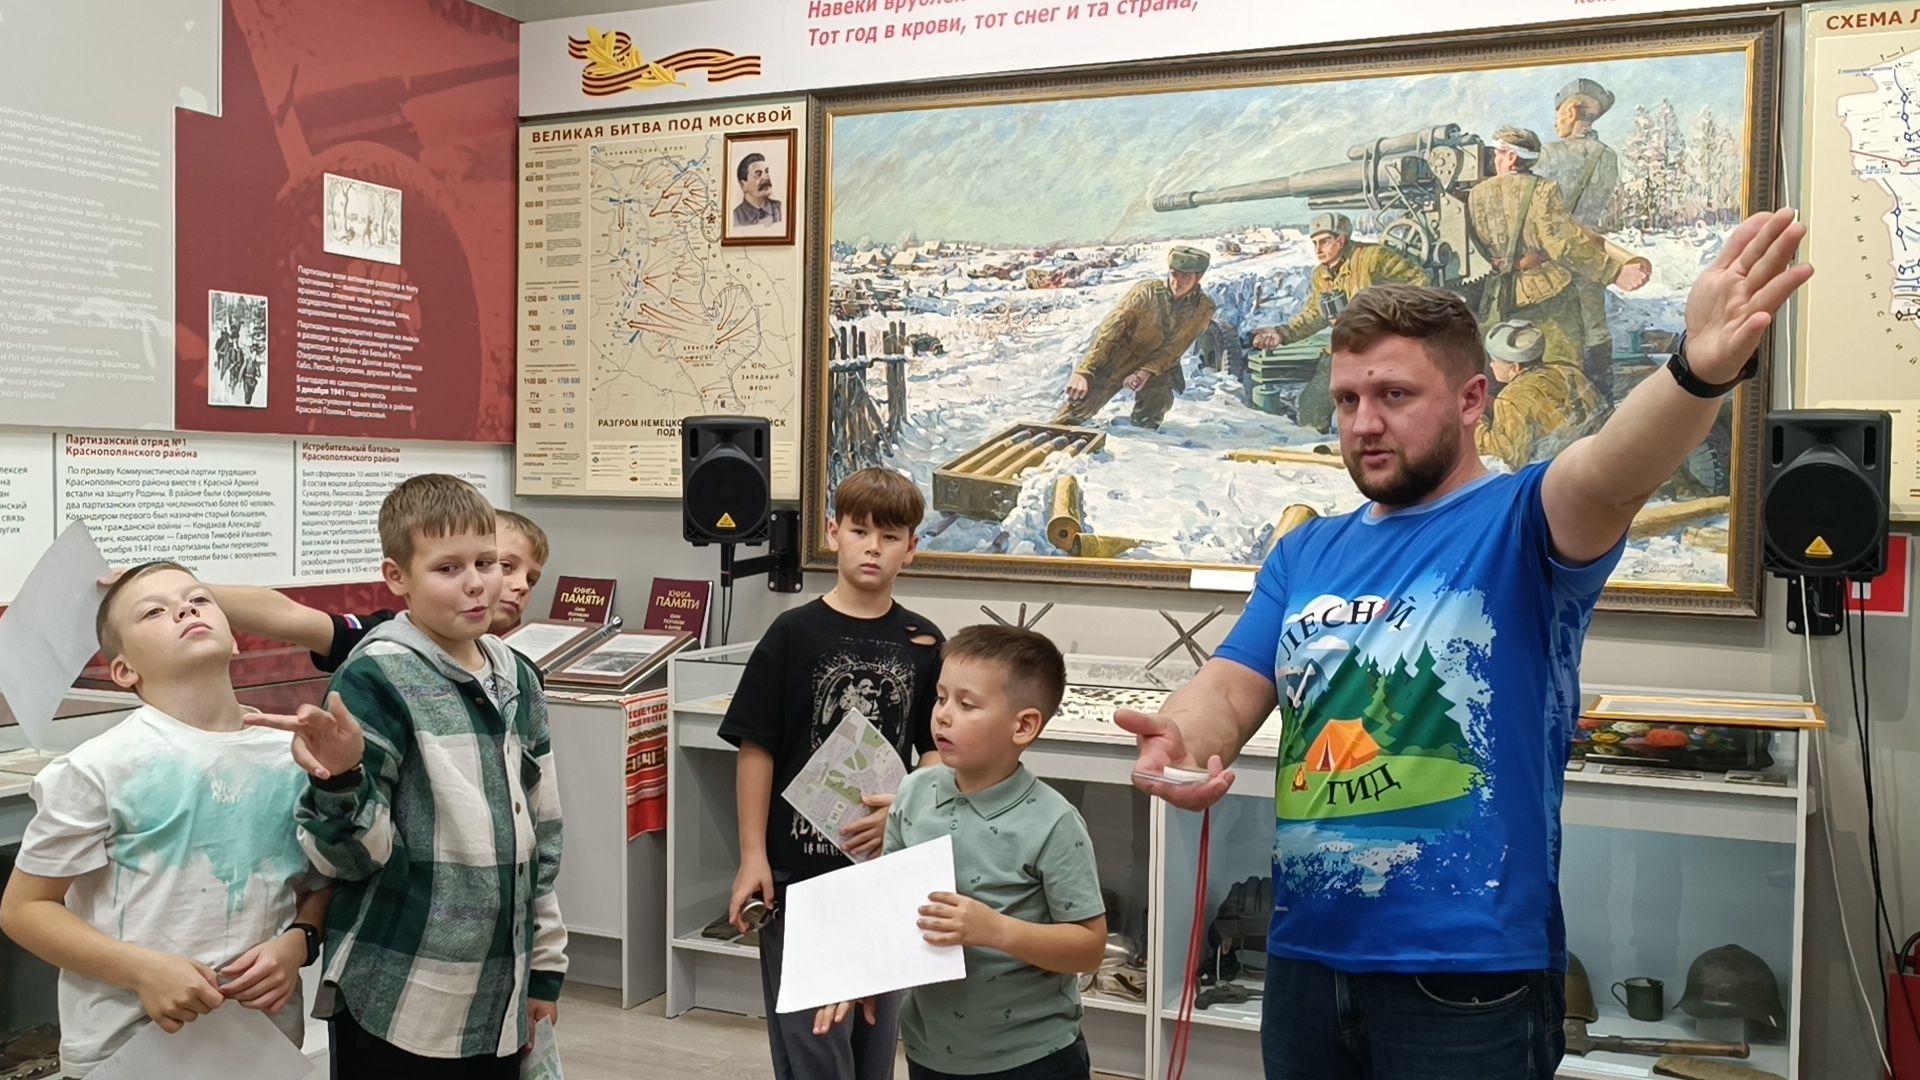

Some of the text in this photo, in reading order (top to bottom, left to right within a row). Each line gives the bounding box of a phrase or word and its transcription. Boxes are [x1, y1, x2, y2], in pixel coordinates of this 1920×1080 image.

[808, 0, 877, 18] Навеки
[808, 0, 1199, 46] Тот год в крови, тот снег и та страна,
[1826, 10, 1903, 30] СХЕМА
[532, 106, 792, 143] ВЕЛИКАЯ БИТВА ПОД МОСКВОЙ
[330, 387, 344, 395] 1941
[598, 419, 639, 428] РАЗГРОМ
[657, 428, 676, 438] ПОД
[65, 434, 138, 446] Партизанский
[140, 438, 169, 447] отряд
[65, 446, 197, 459] Краснополянского района
[302, 442, 400, 453] Истребительный батальон
[302, 452, 399, 464] Краснополянского района
[116, 467, 189, 476] Коммунистической
[217, 469, 256, 477] трудящиеся
[65, 478, 140, 487] Краснополянского
[141, 478, 169, 487] района
[203, 478, 232, 487] Красной
[233, 478, 258, 487] Армией
[135, 489, 166, 498] Родины.
[174, 489, 201, 498] районе
[222, 489, 271, 497] сформированы
[65, 511, 117, 520] Командиром
[204, 510, 229, 519] старый
[104, 522, 156, 531] гражданской
[156, 521, 181, 529] войны
[192, 521, 226, 530] Кондаков
[116, 534, 164, 542] комиссаром
[175, 531, 209, 541] Гаврилов
[103, 544, 132, 553] ноября
[172, 544, 210, 552] партизаны
[573, 586, 596, 595] КНИГА
[668, 590, 691, 599] КНИГА
[560, 592, 605, 606] ПАМЯТИ
[655, 596, 700, 610] ПАМЯТИ
[1280, 596, 1416, 661] ЛЕСНЙ
[1326, 763, 1402, 805] ГИД
